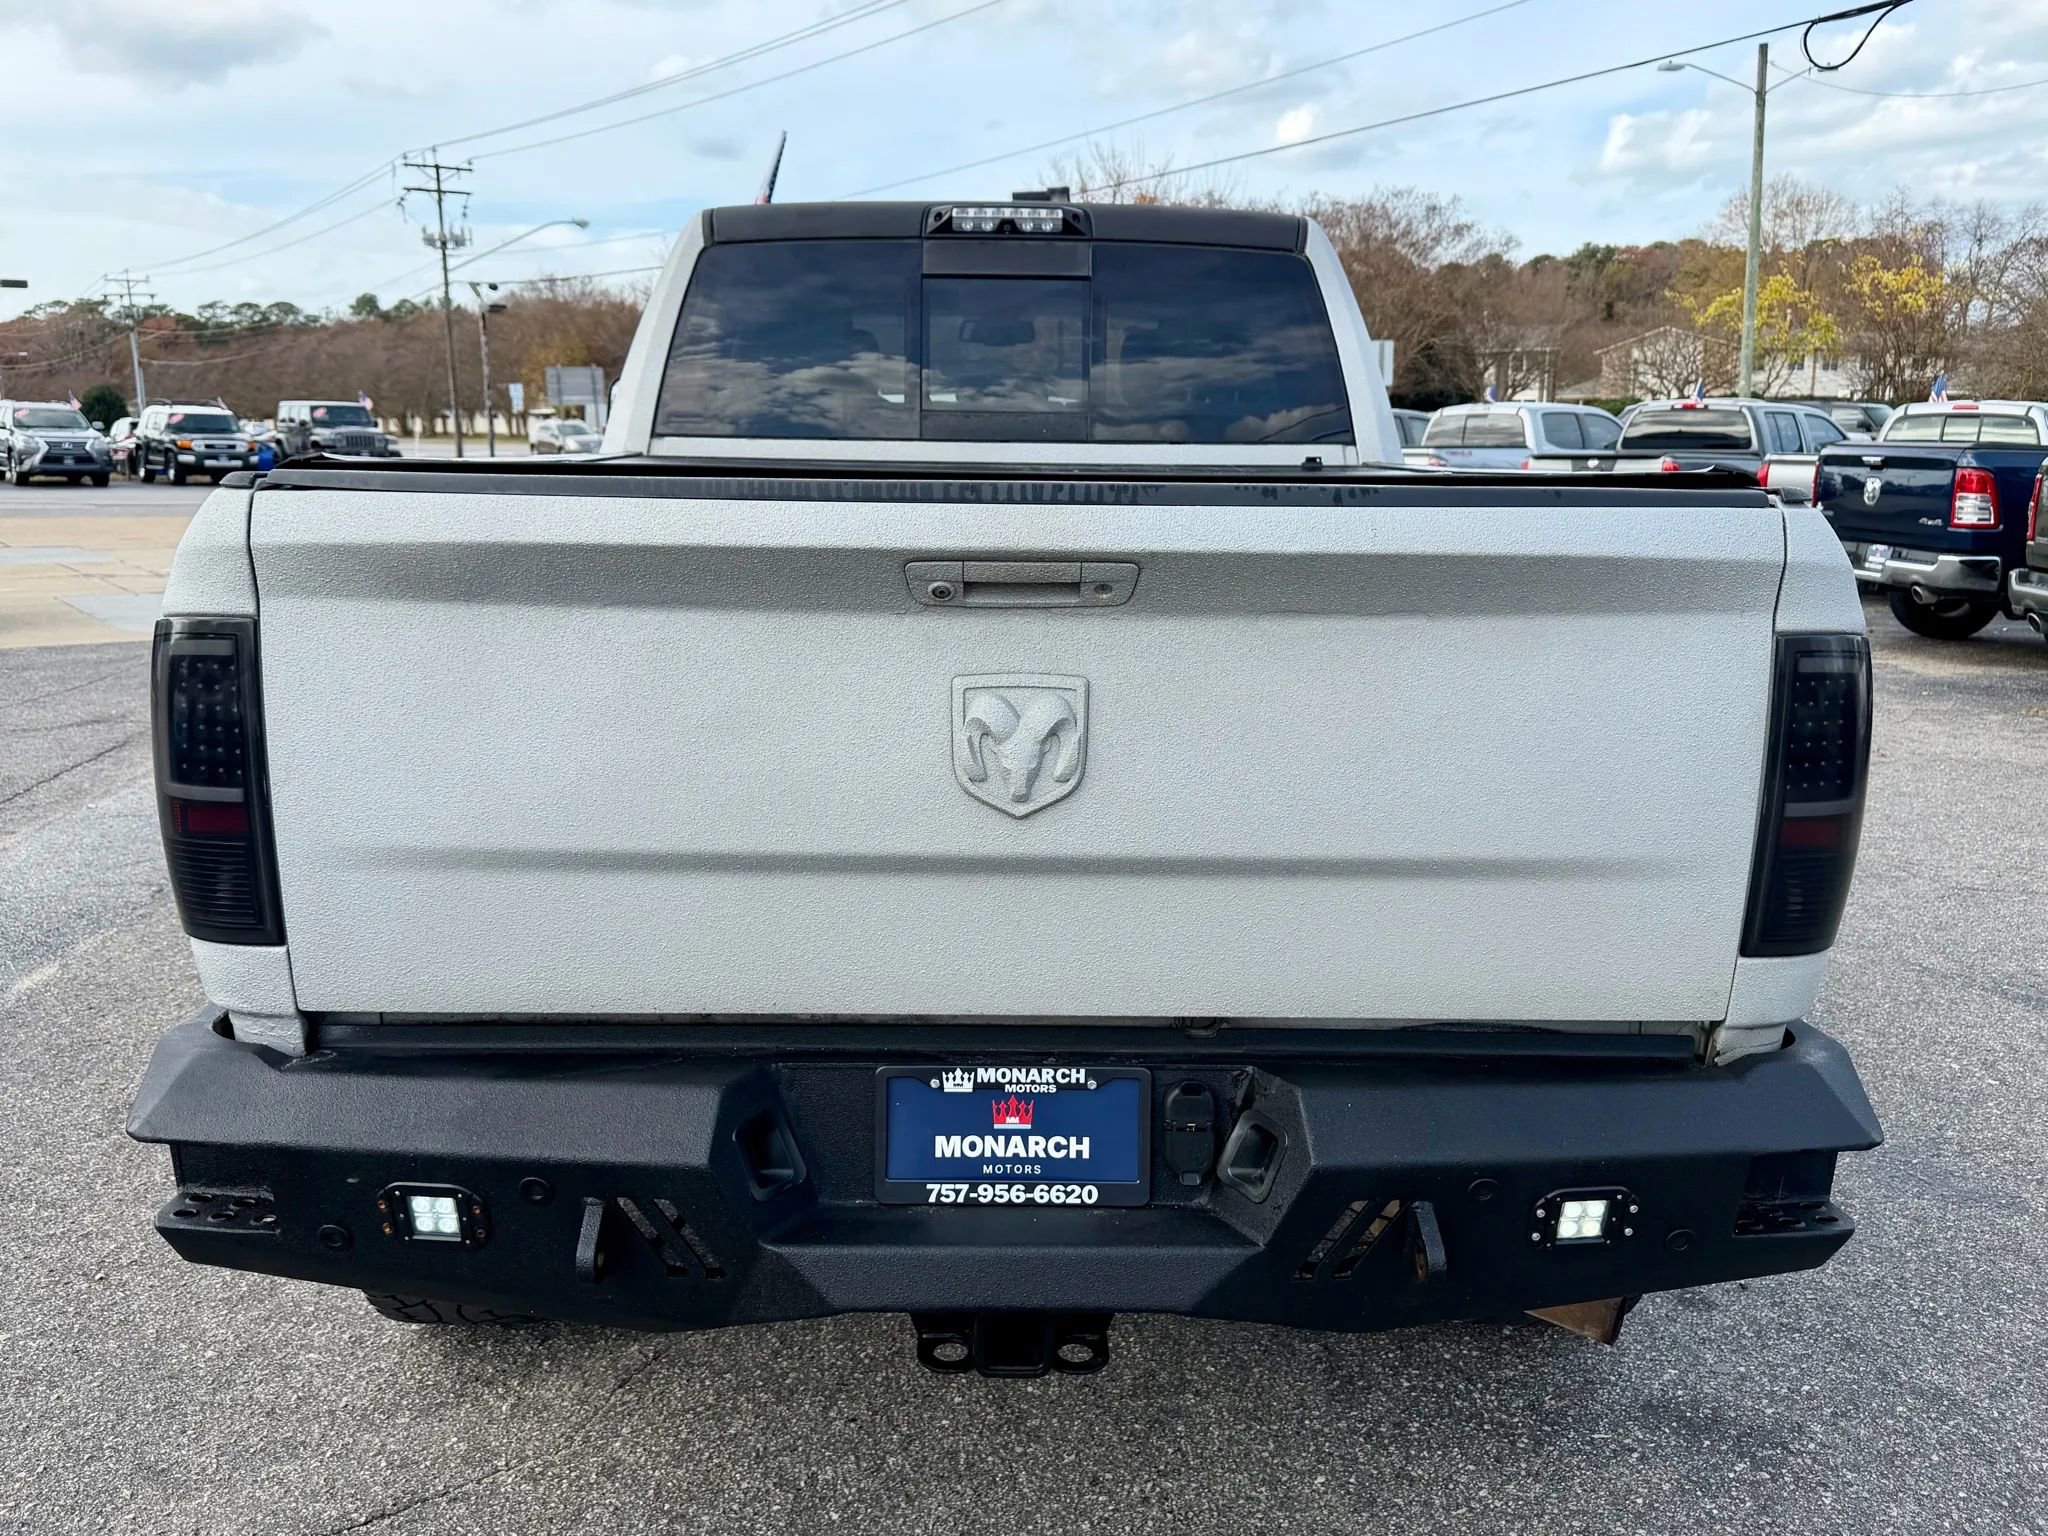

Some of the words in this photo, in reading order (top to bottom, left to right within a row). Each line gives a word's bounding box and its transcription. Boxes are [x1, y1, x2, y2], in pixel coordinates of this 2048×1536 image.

[976, 1067, 1086, 1084] MONARCH
[1004, 1084, 1057, 1093] MOTORS
[1005, 1116, 1020, 1124] MM
[935, 1135, 1090, 1159] MONARCH
[983, 1164, 1042, 1175] MOTORS
[926, 1184, 1099, 1204] 757-956-6620
